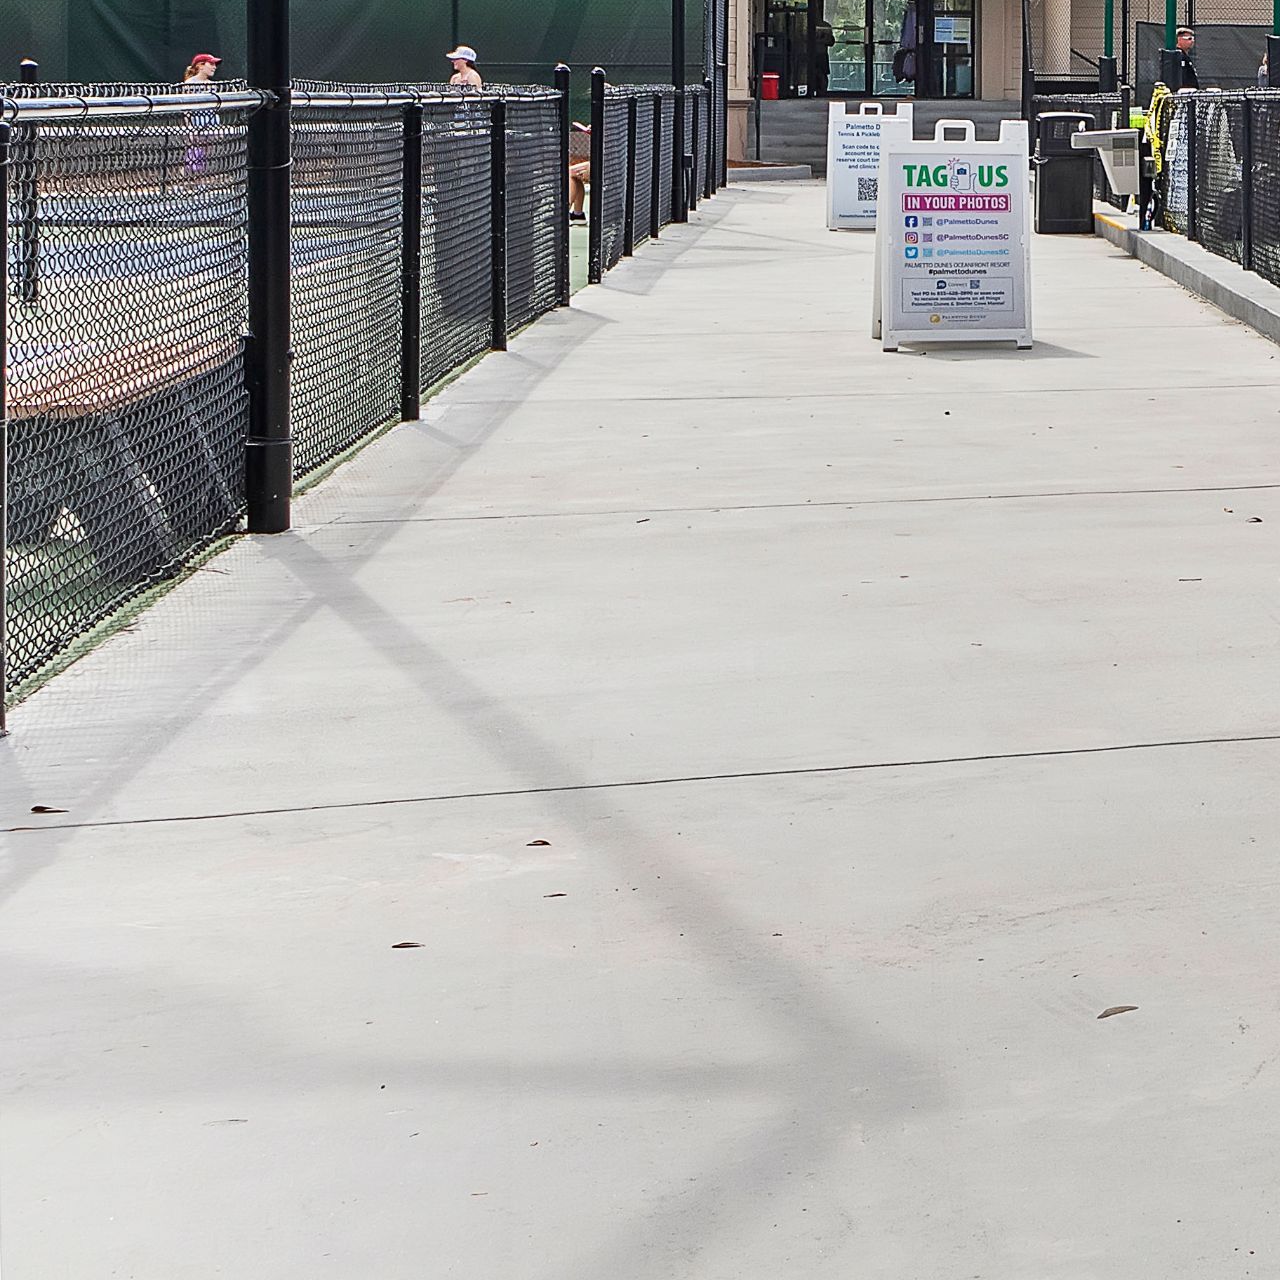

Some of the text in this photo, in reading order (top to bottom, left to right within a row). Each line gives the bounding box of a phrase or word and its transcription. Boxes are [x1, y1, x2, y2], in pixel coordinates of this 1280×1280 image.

[902, 165, 1008, 187] TAG US
[907, 196, 1006, 209] IN YOUR PHOTOS
[936, 218, 998, 226] @PalmettoDunes
[936, 233, 1009, 242] @PalmettoDunesSC
[936, 249, 1009, 257] @PalmettoDunesSC
